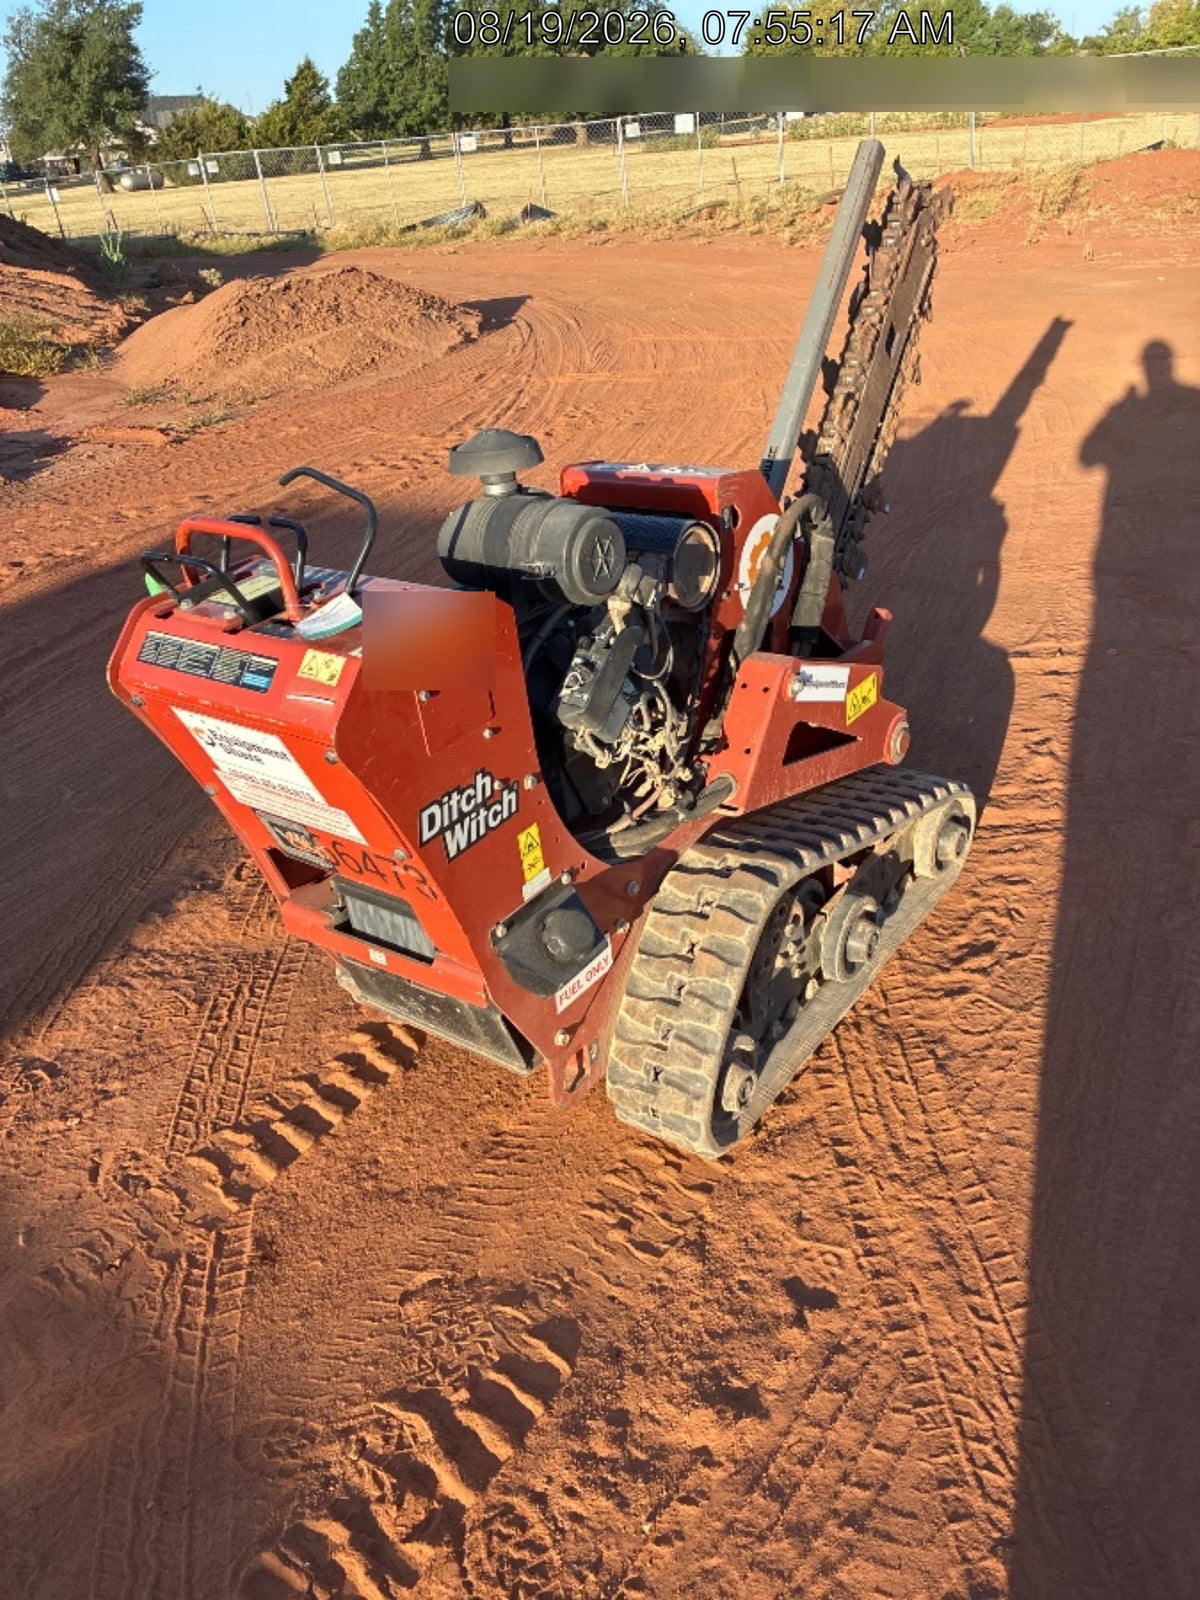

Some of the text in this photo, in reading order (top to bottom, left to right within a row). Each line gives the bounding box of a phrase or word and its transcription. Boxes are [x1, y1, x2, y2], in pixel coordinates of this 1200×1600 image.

[419, 770, 493, 844] Ditch
[443, 786, 518, 860] Witch
[559, 954, 610, 1006] FUEL ONLY
